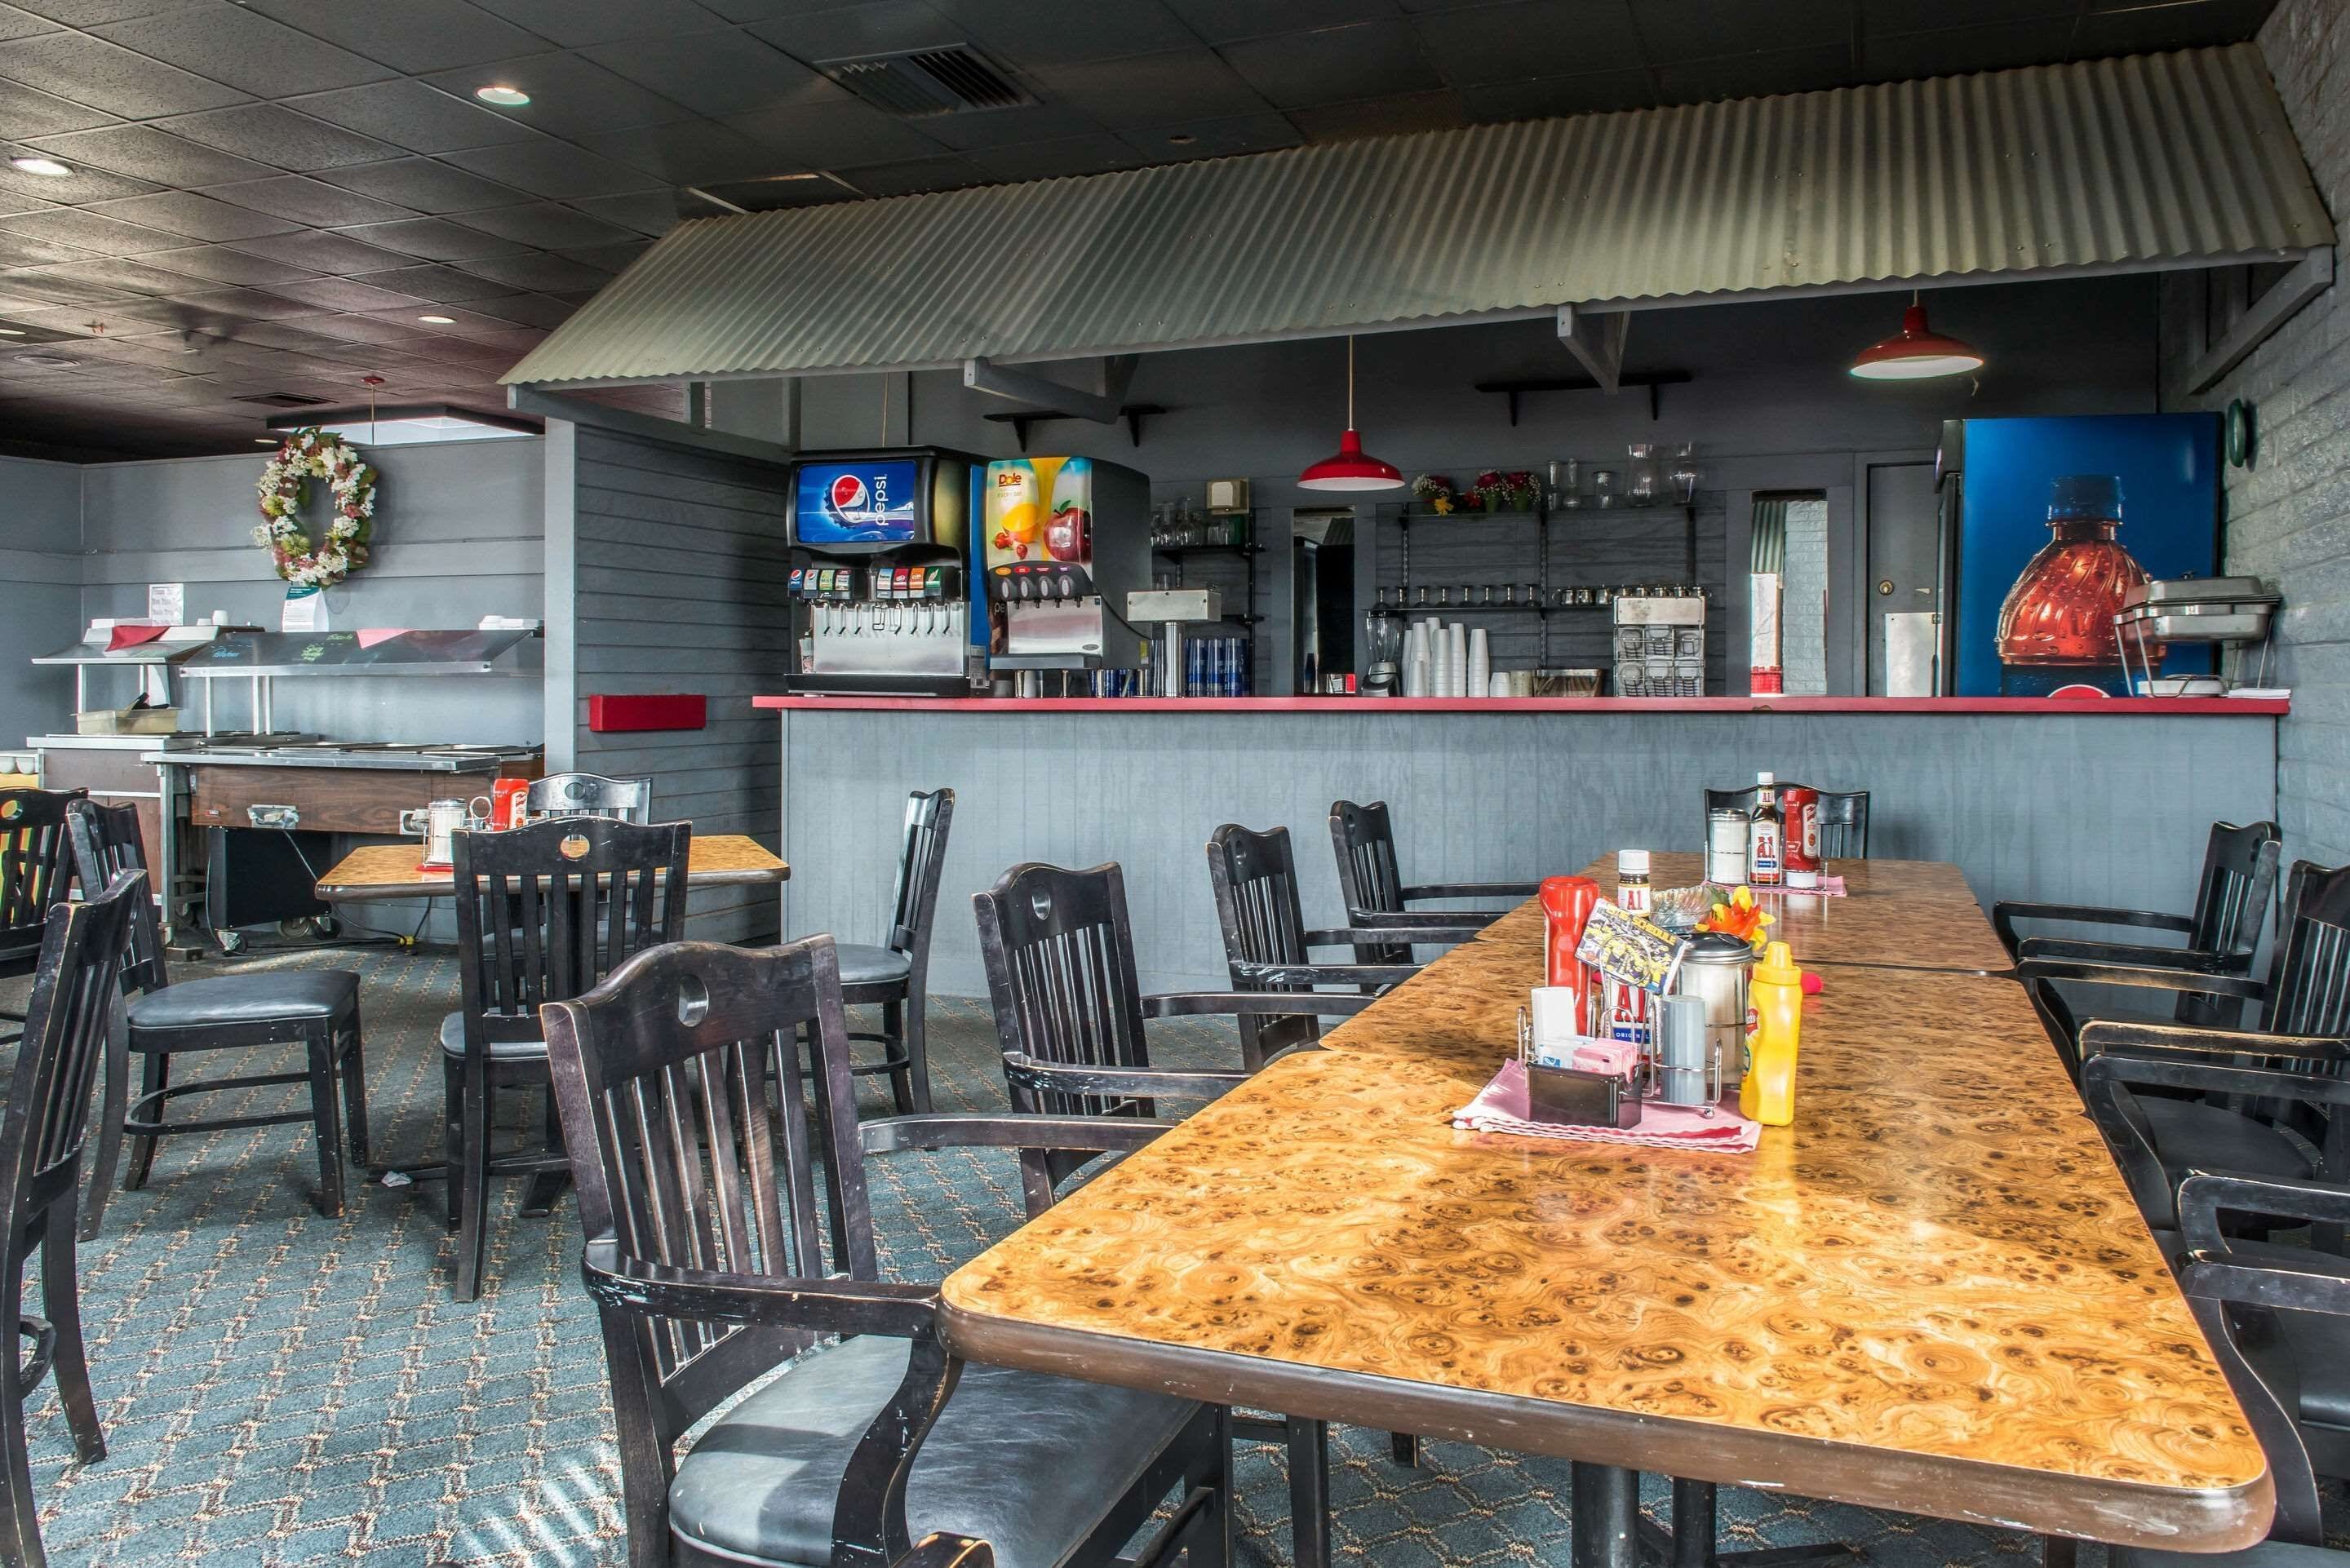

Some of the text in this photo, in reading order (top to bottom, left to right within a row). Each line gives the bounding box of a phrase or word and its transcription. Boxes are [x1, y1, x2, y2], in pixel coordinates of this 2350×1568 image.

[998, 472, 1022, 485] Dole
[874, 476, 889, 526] pepsi
[1626, 890, 1643, 910] A1
[1630, 915, 1677, 946] SCHEDULE
